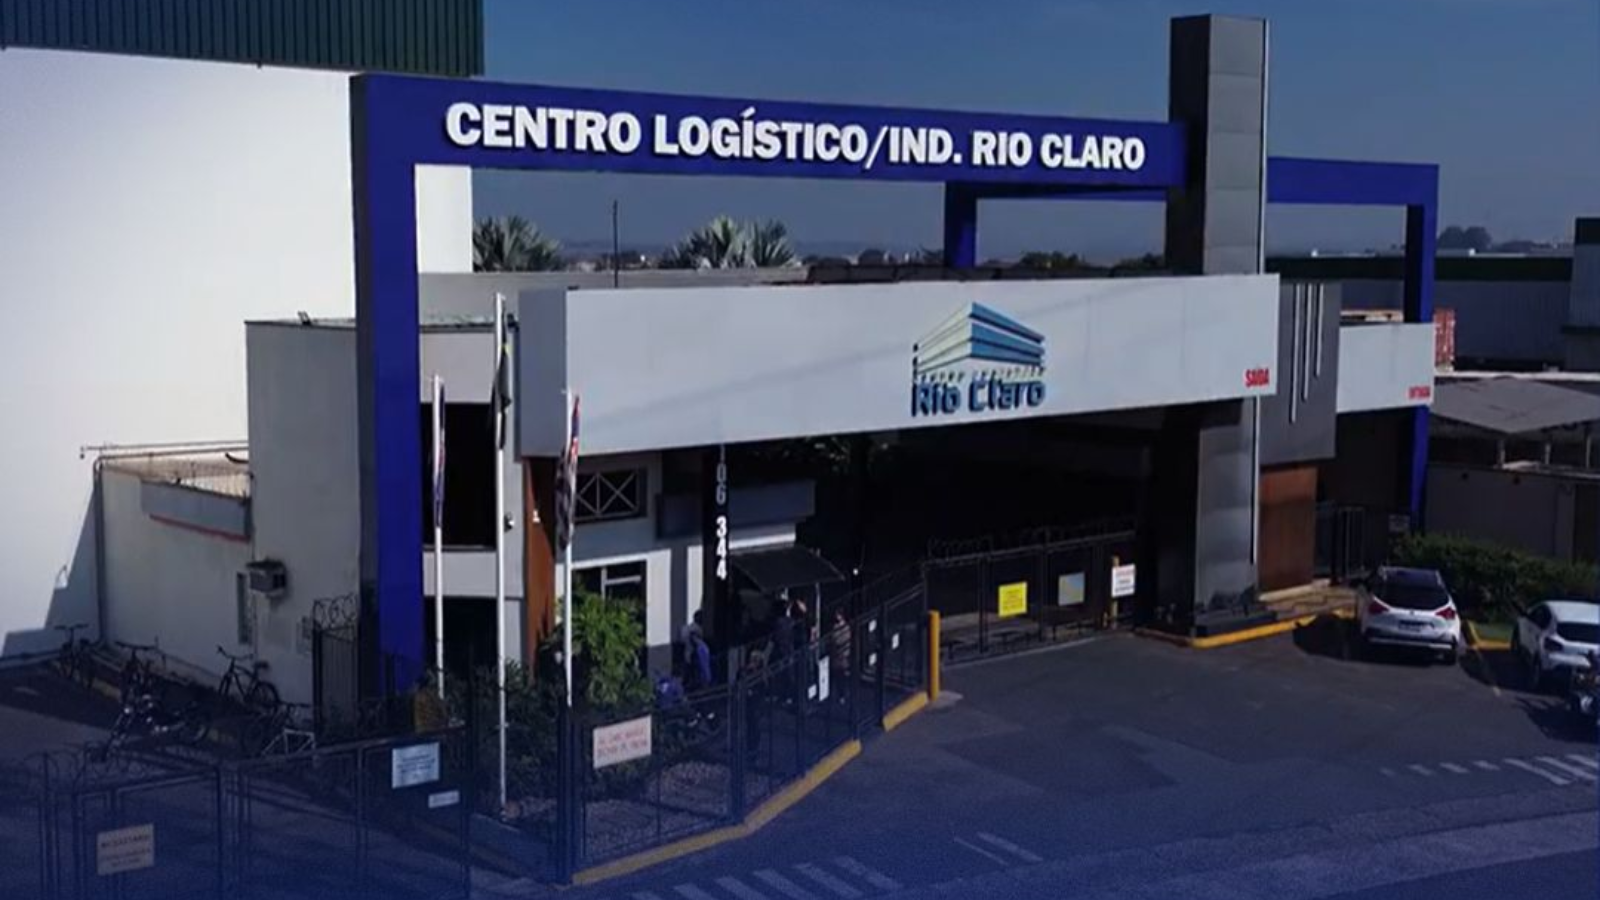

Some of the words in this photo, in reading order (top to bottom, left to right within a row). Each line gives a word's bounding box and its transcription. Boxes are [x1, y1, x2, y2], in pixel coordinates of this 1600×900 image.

[446, 102, 643, 153] CENTRO
[654, 106, 964, 170] LOGÍSTICO/IND.
[972, 131, 1034, 168] RIO
[1040, 133, 1147, 171] CLARO
[911, 382, 961, 417] Rio
[968, 376, 1046, 412] Claro
[716, 515, 727, 580] 344
